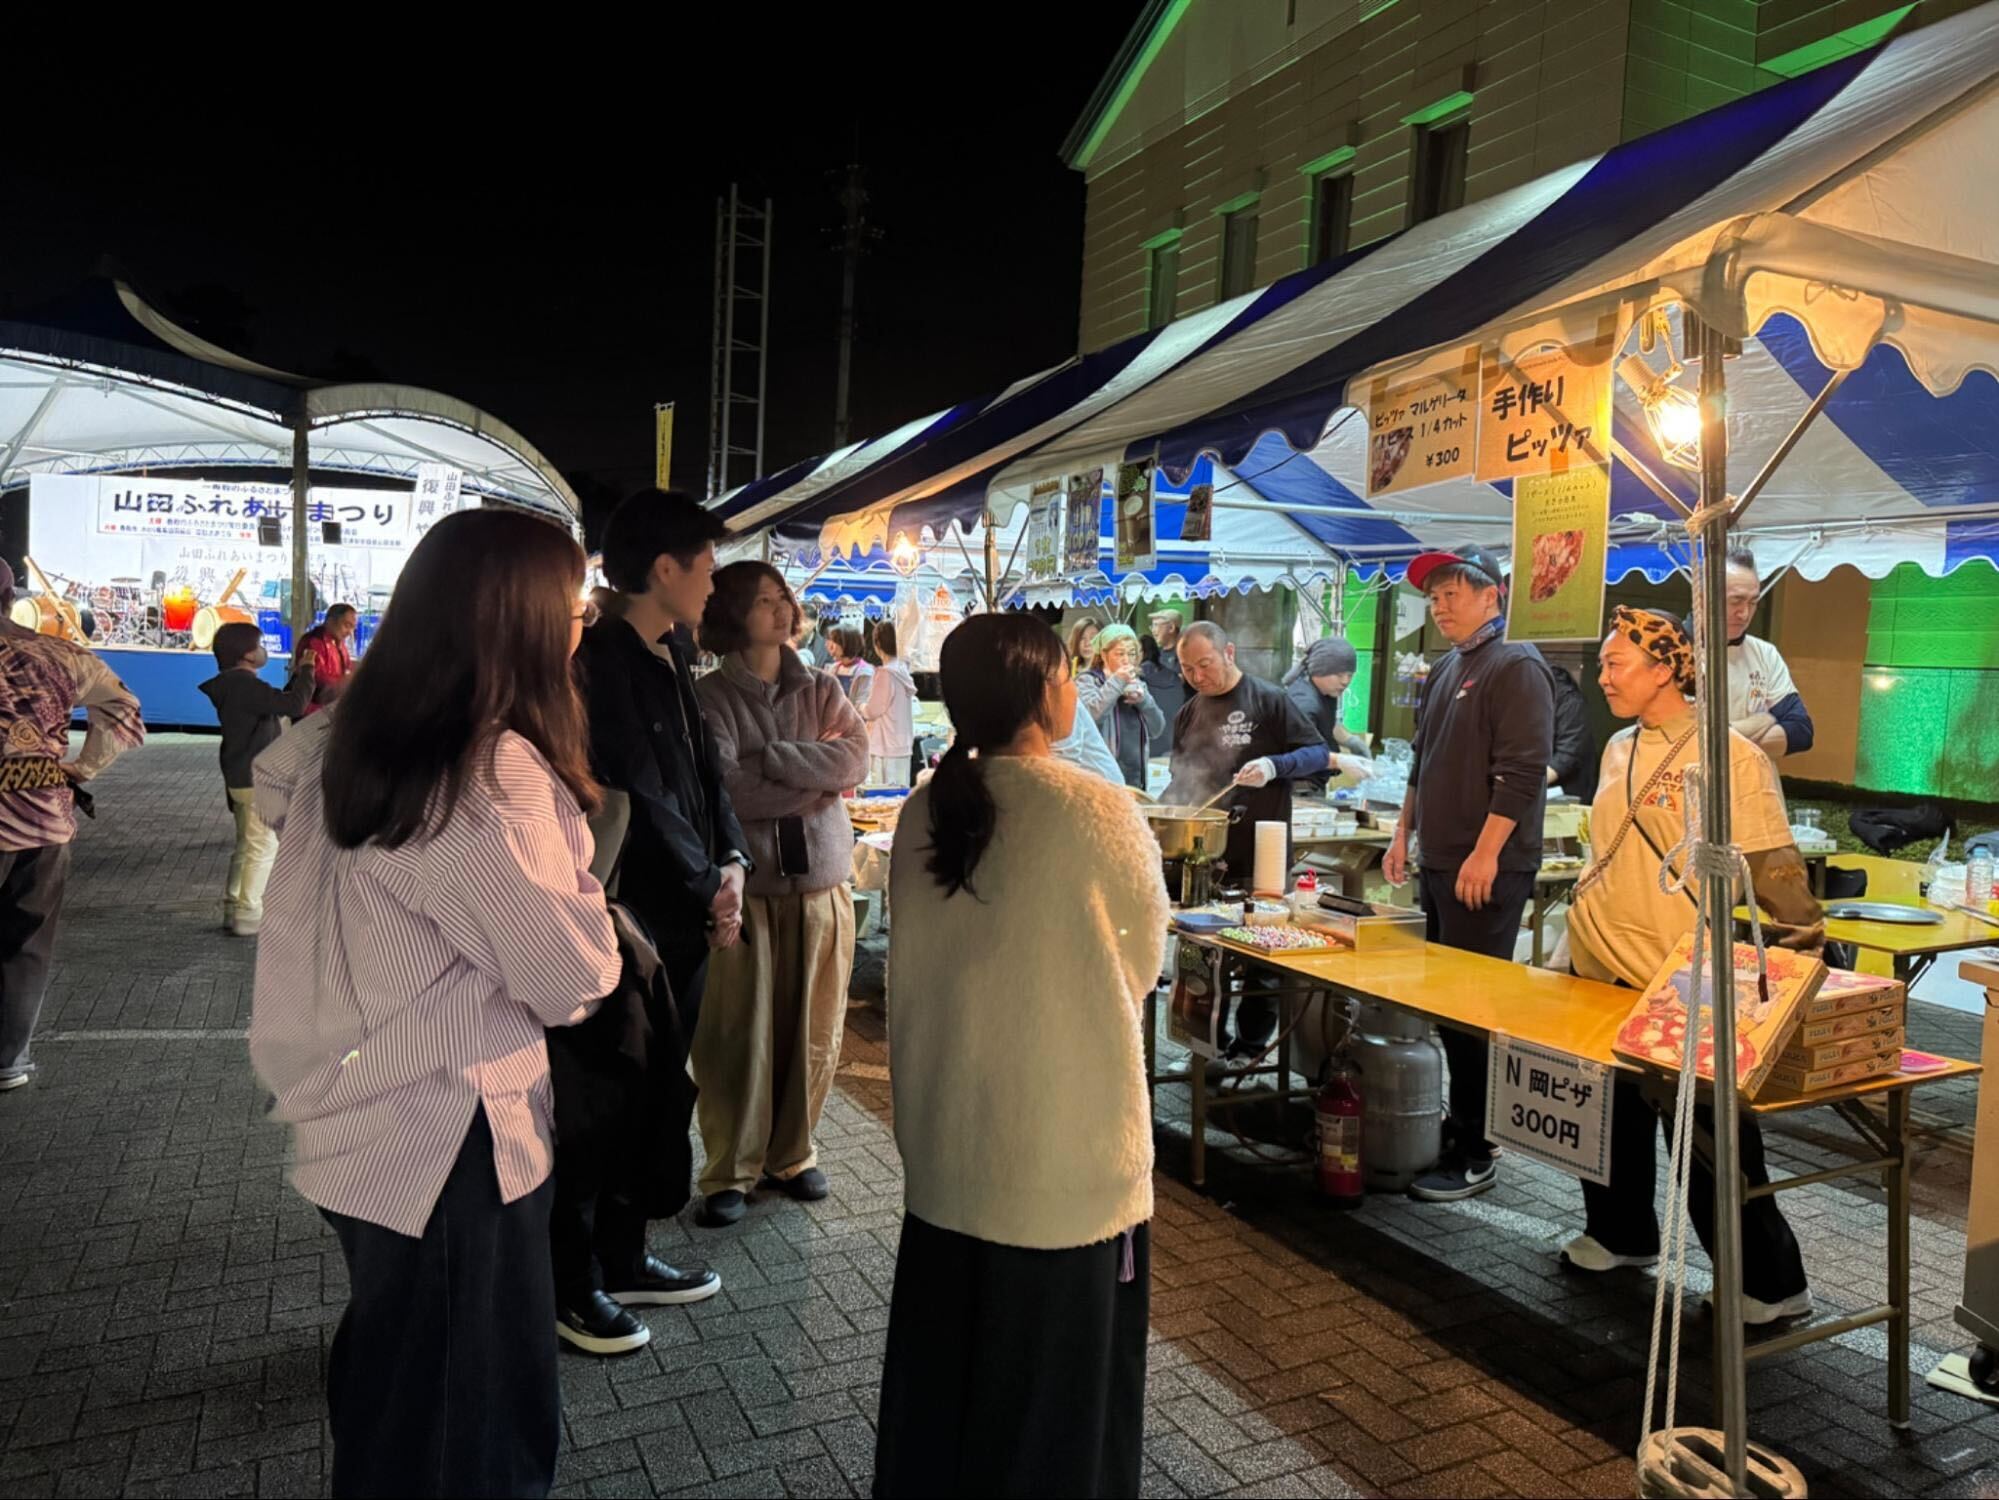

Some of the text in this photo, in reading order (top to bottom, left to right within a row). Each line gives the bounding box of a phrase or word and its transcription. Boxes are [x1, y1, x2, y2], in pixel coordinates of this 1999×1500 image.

[1375, 408, 1405, 429] ピッツァ
[1410, 389, 1467, 415] マルゲリータ
[1492, 376, 1564, 420] 手作り
[1421, 412, 1467, 437] 1/4カット
[1506, 423, 1592, 462] ピッツァ
[1426, 447, 1460, 468] ¥300
[114, 490, 394, 526] 山田ふれあいまつり
[1506, 1054, 1593, 1108] N 岡ピザ
[1511, 1103, 1580, 1150] 300円
